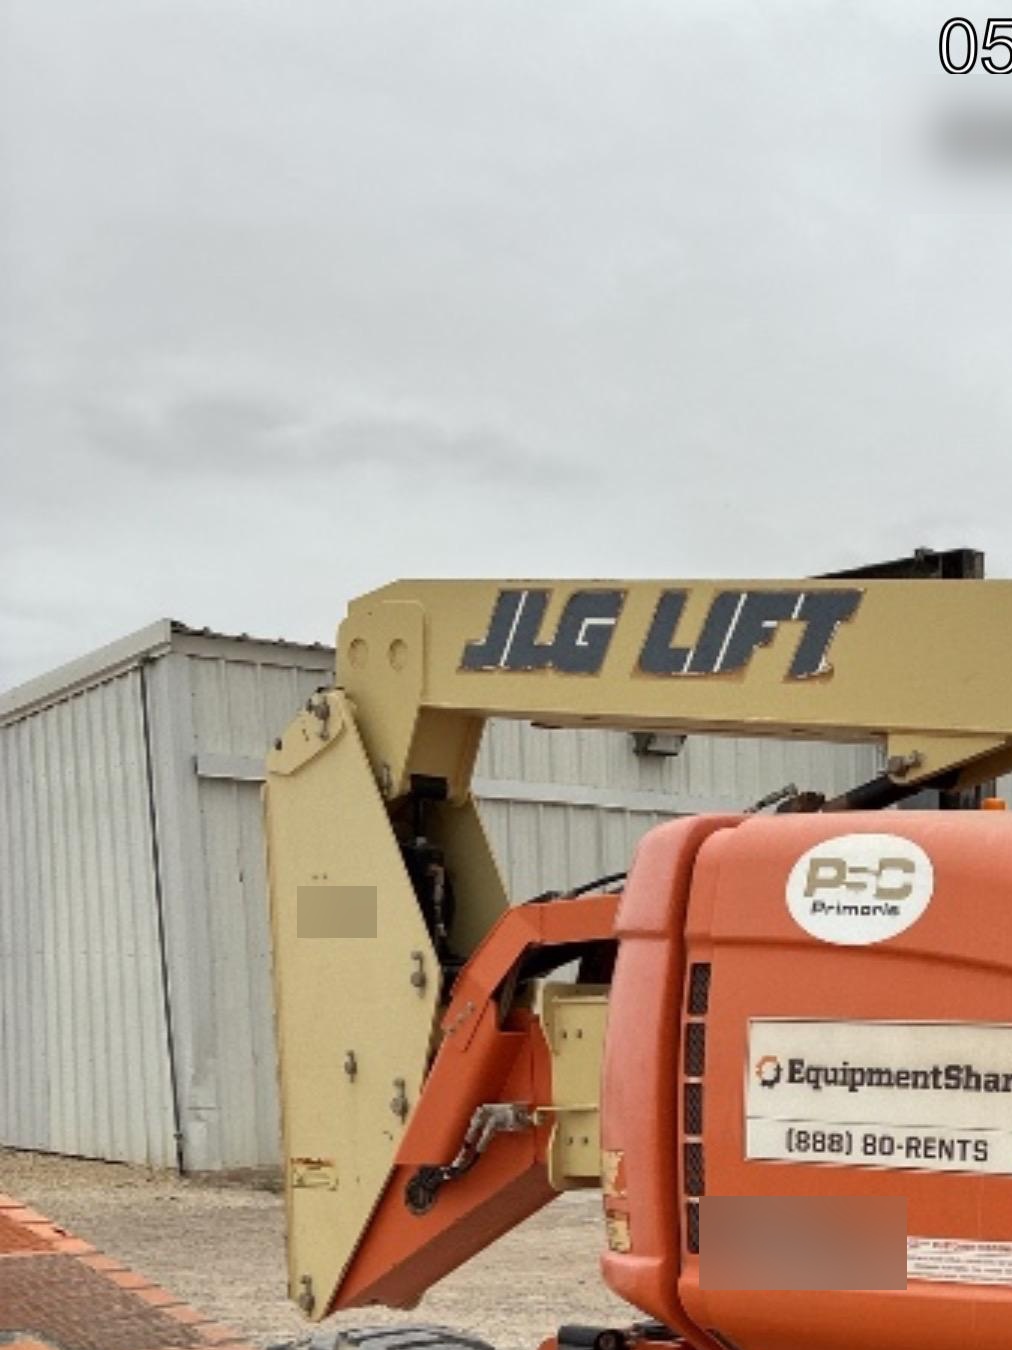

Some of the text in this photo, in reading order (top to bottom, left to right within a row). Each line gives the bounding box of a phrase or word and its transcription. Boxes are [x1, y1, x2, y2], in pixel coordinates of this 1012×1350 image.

[459, 589, 866, 679] JLG LIFT
[785, 1127, 989, 1162] (888) 80-RENTS
